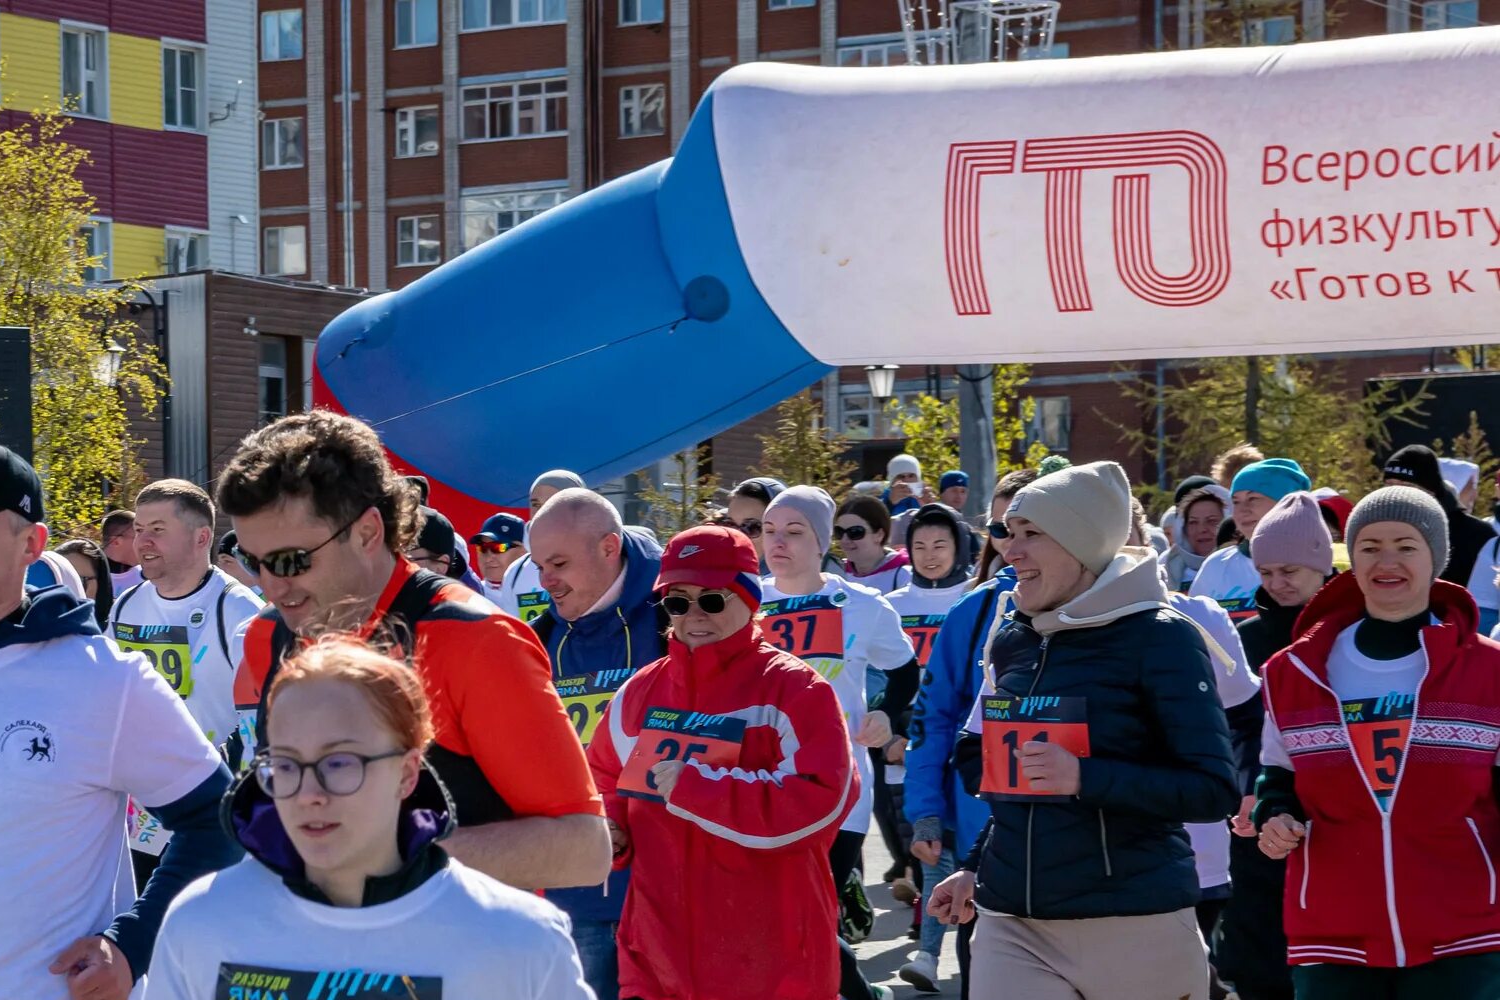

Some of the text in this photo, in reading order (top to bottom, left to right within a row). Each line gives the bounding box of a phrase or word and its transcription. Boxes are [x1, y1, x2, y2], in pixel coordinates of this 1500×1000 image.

[945, 130, 1231, 315] ГТО
[1260, 207, 1500, 258] физкульту
[1270, 267, 1432, 301] «Готов
[1448, 268, 1476, 294] к
[771, 614, 818, 653] 37
[1002, 730, 1049, 788] 1
[1373, 728, 1404, 784] 5
[231, 971, 291, 992] РАЗБУДИ
